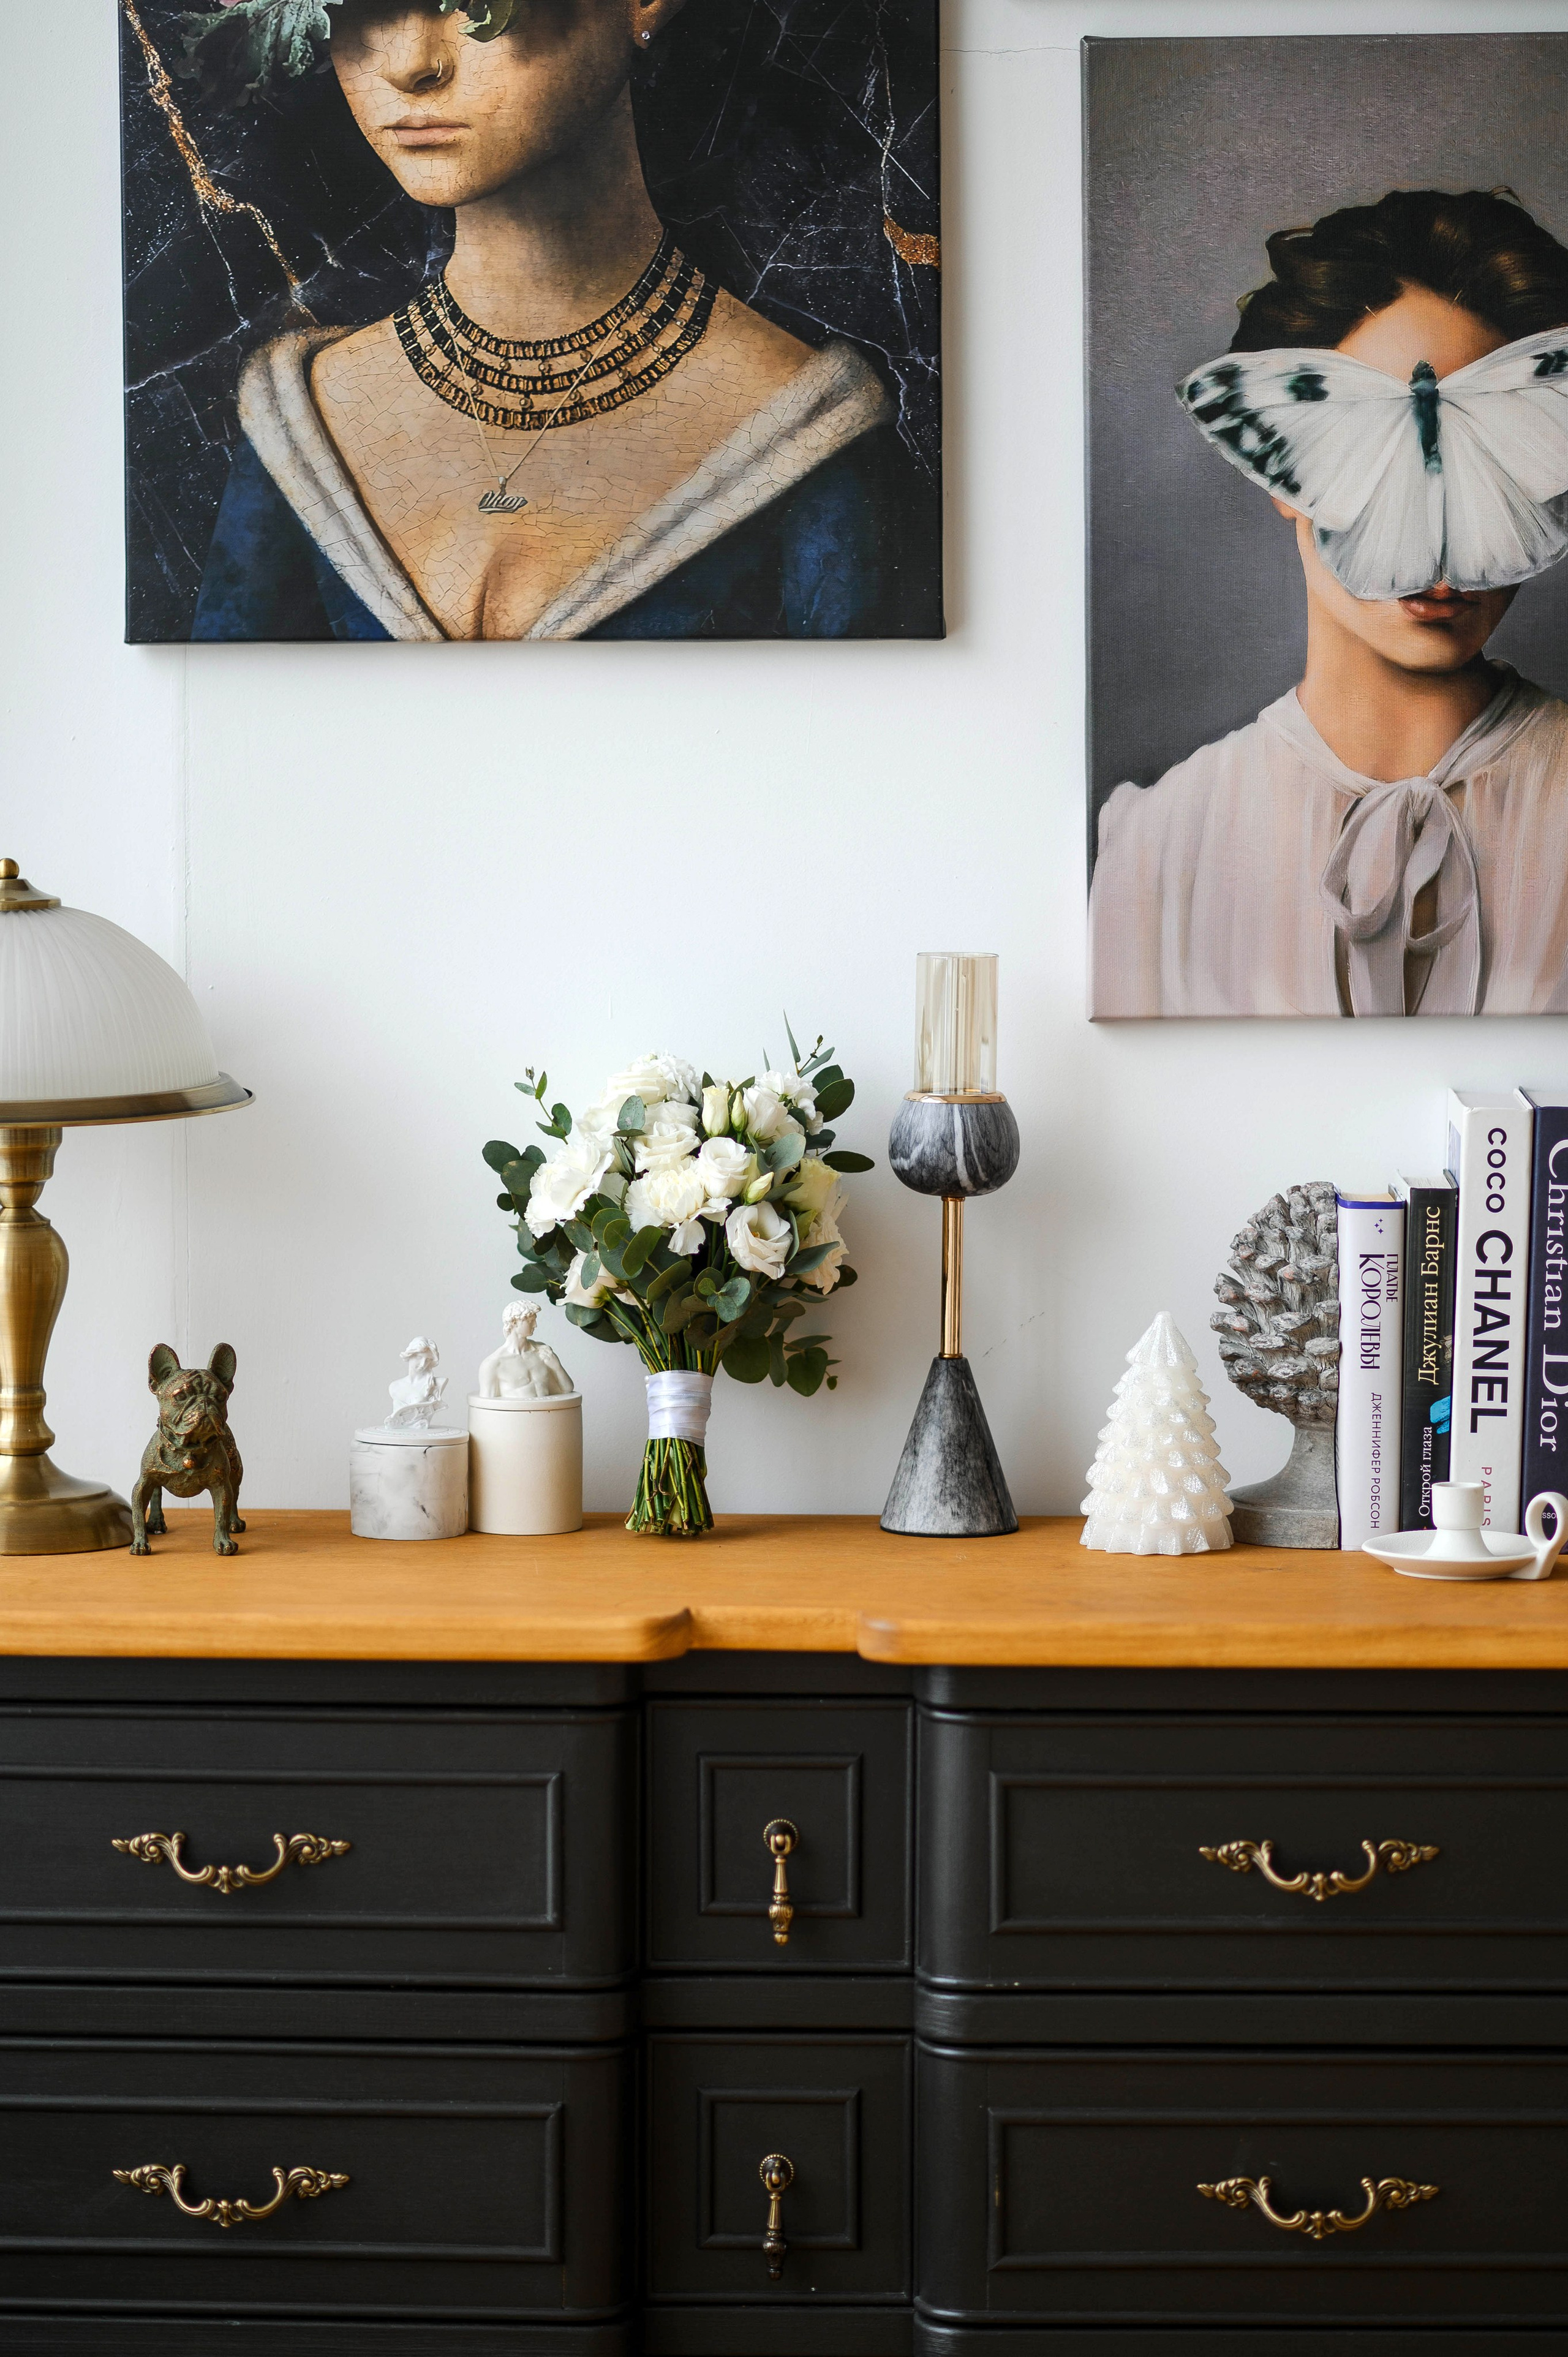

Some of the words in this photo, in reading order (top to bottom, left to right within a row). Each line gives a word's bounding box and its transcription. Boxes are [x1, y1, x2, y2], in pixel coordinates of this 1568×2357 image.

[1485, 1127, 1507, 1213] COCO
[1385, 1253, 1399, 1303] ПЛАТЬЕ
[1420, 1206, 1445, 1277] Барнс
[1359, 1253, 1385, 1370] КОРОЛЕВЫ
[1418, 1282, 1442, 1385] Джулиан
[1470, 1229, 1513, 1433] CHANEL
[1370, 1392, 1382, 1474] ДЖЕННИФЕР
[1540, 1344, 1568, 1452] Dior
[1422, 1426, 1433, 1460] глаза
[1370, 1477, 1381, 1529] РОБСОН
[1418, 1465, 1433, 1517] Открой
